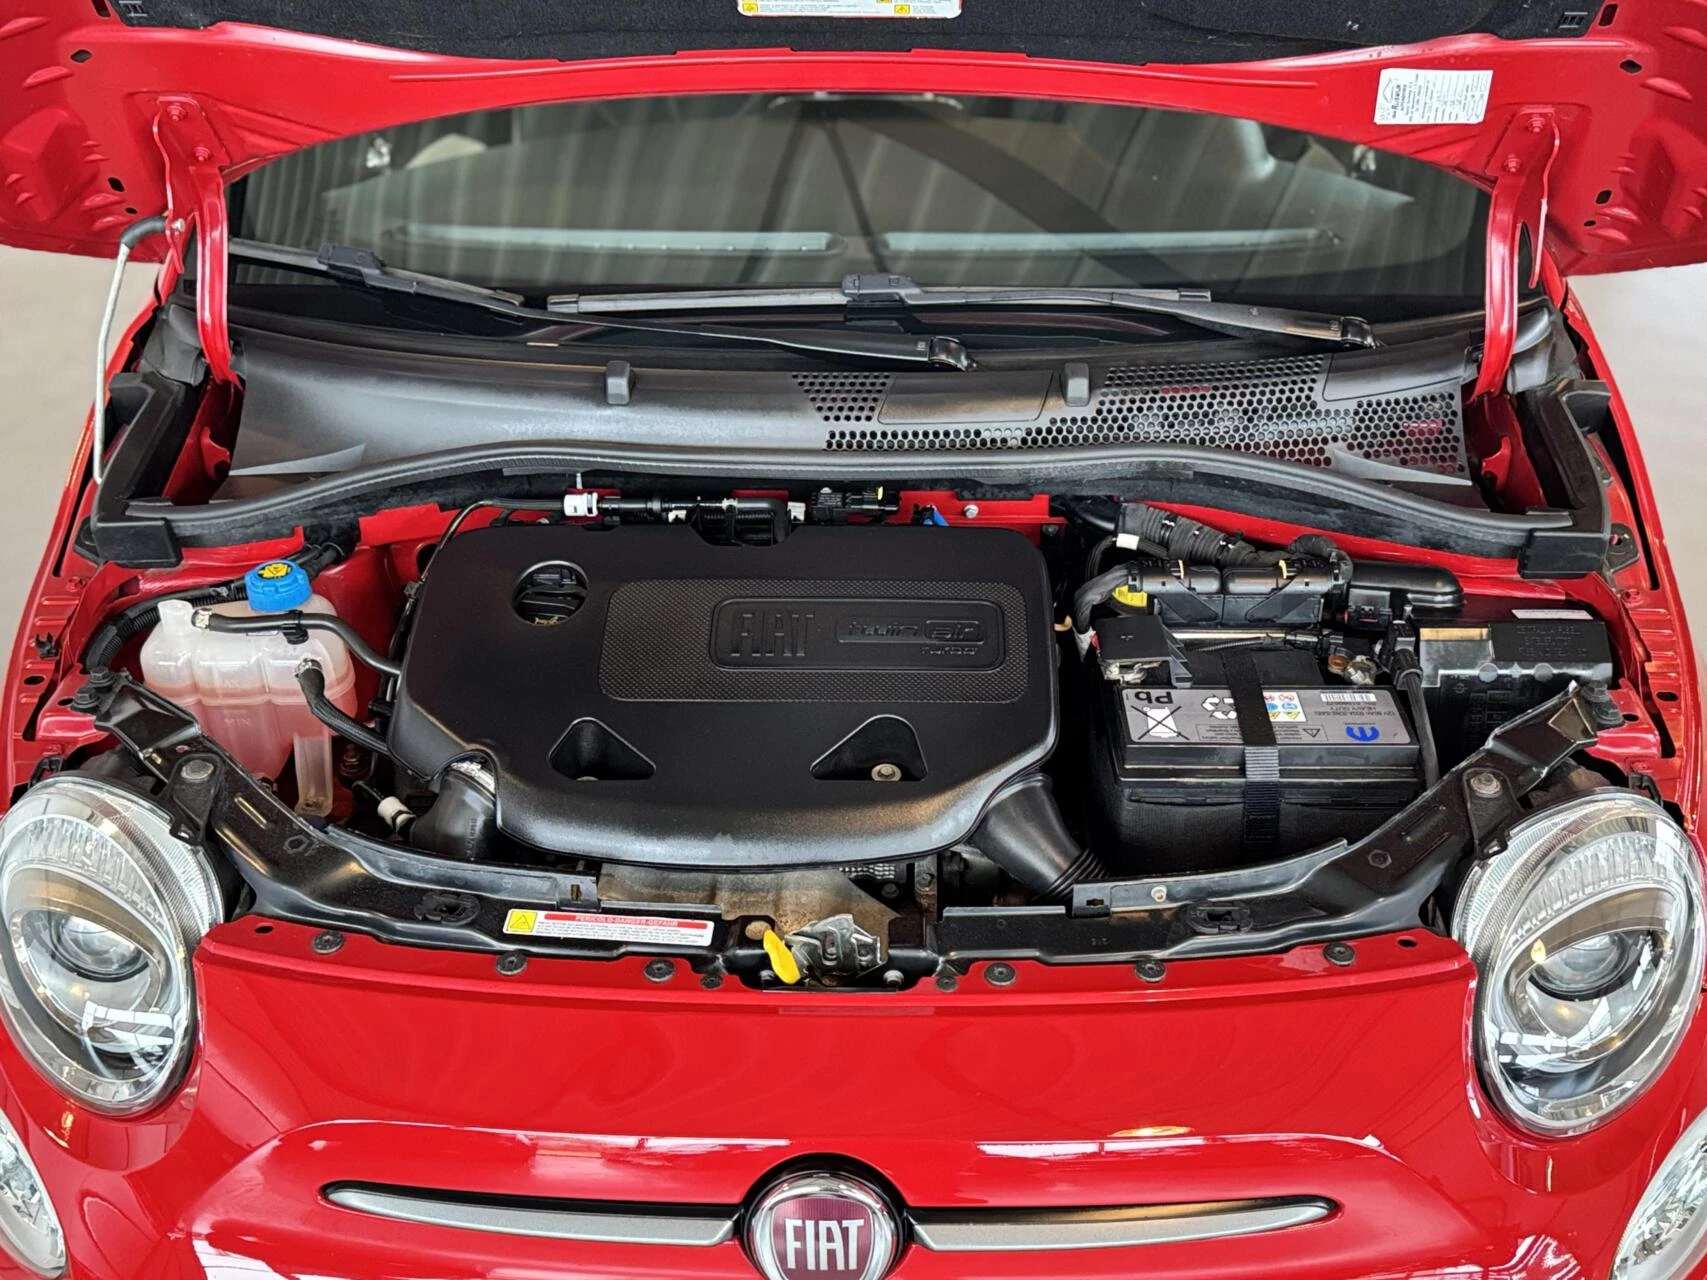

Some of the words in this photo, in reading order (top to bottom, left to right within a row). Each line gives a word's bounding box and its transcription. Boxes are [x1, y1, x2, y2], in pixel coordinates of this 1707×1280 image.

[731, 609, 815, 656] FIAT
[1134, 691, 1174, 704] Pb
[785, 1218, 865, 1270] FIAT
